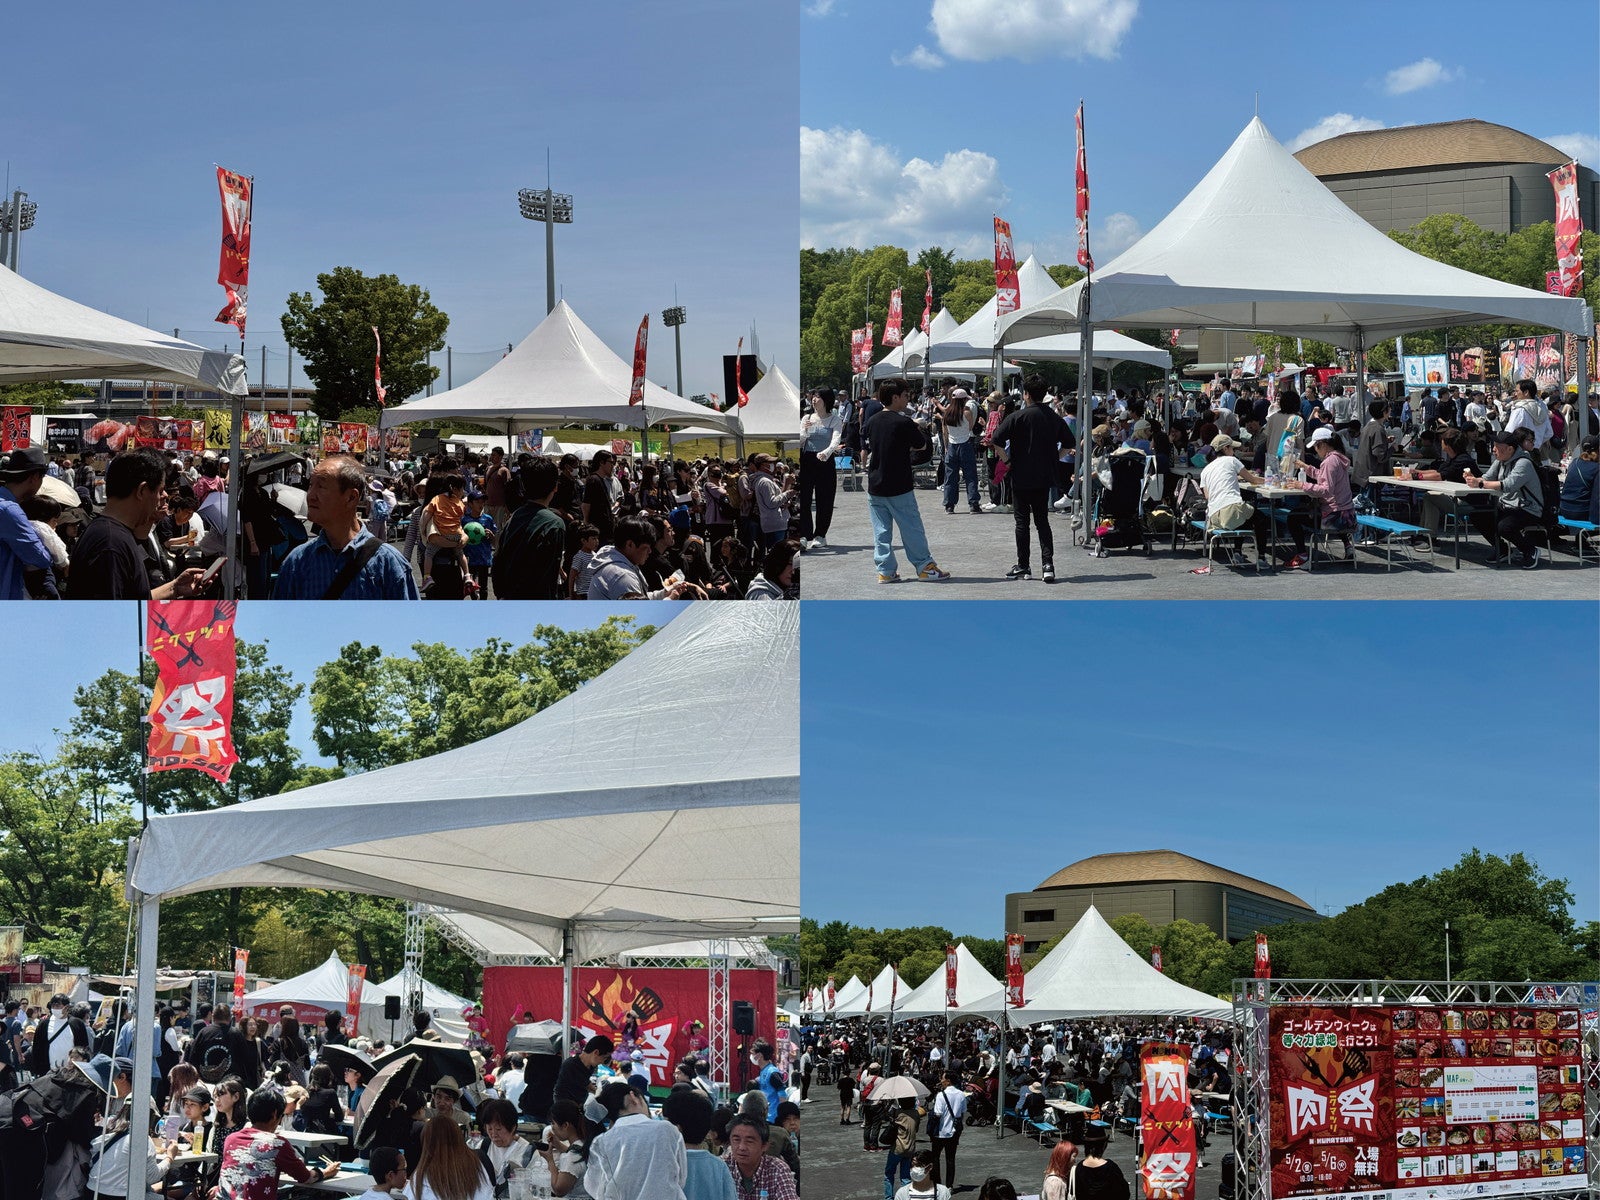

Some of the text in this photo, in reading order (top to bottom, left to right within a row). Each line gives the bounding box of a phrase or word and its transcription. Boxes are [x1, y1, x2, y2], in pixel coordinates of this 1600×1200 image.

[996, 232, 1014, 260] 肉
[158, 675, 228, 759] 祭
[1284, 1020, 1377, 1031] ゴールデンウィークは
[1145, 1060, 1187, 1105] 肉
[1446, 1073, 1458, 1083] MAP
[1287, 1086, 1328, 1136] 肉
[1329, 1090, 1337, 1132] ニクマツリ
[1337, 1079, 1374, 1131] 祭
[1144, 1120, 1193, 1130] ニクマツリ
[1353, 1160, 1379, 1176] 無料
[1354, 1146, 1380, 1161] 入場
[1145, 1153, 1192, 1199] 祭
